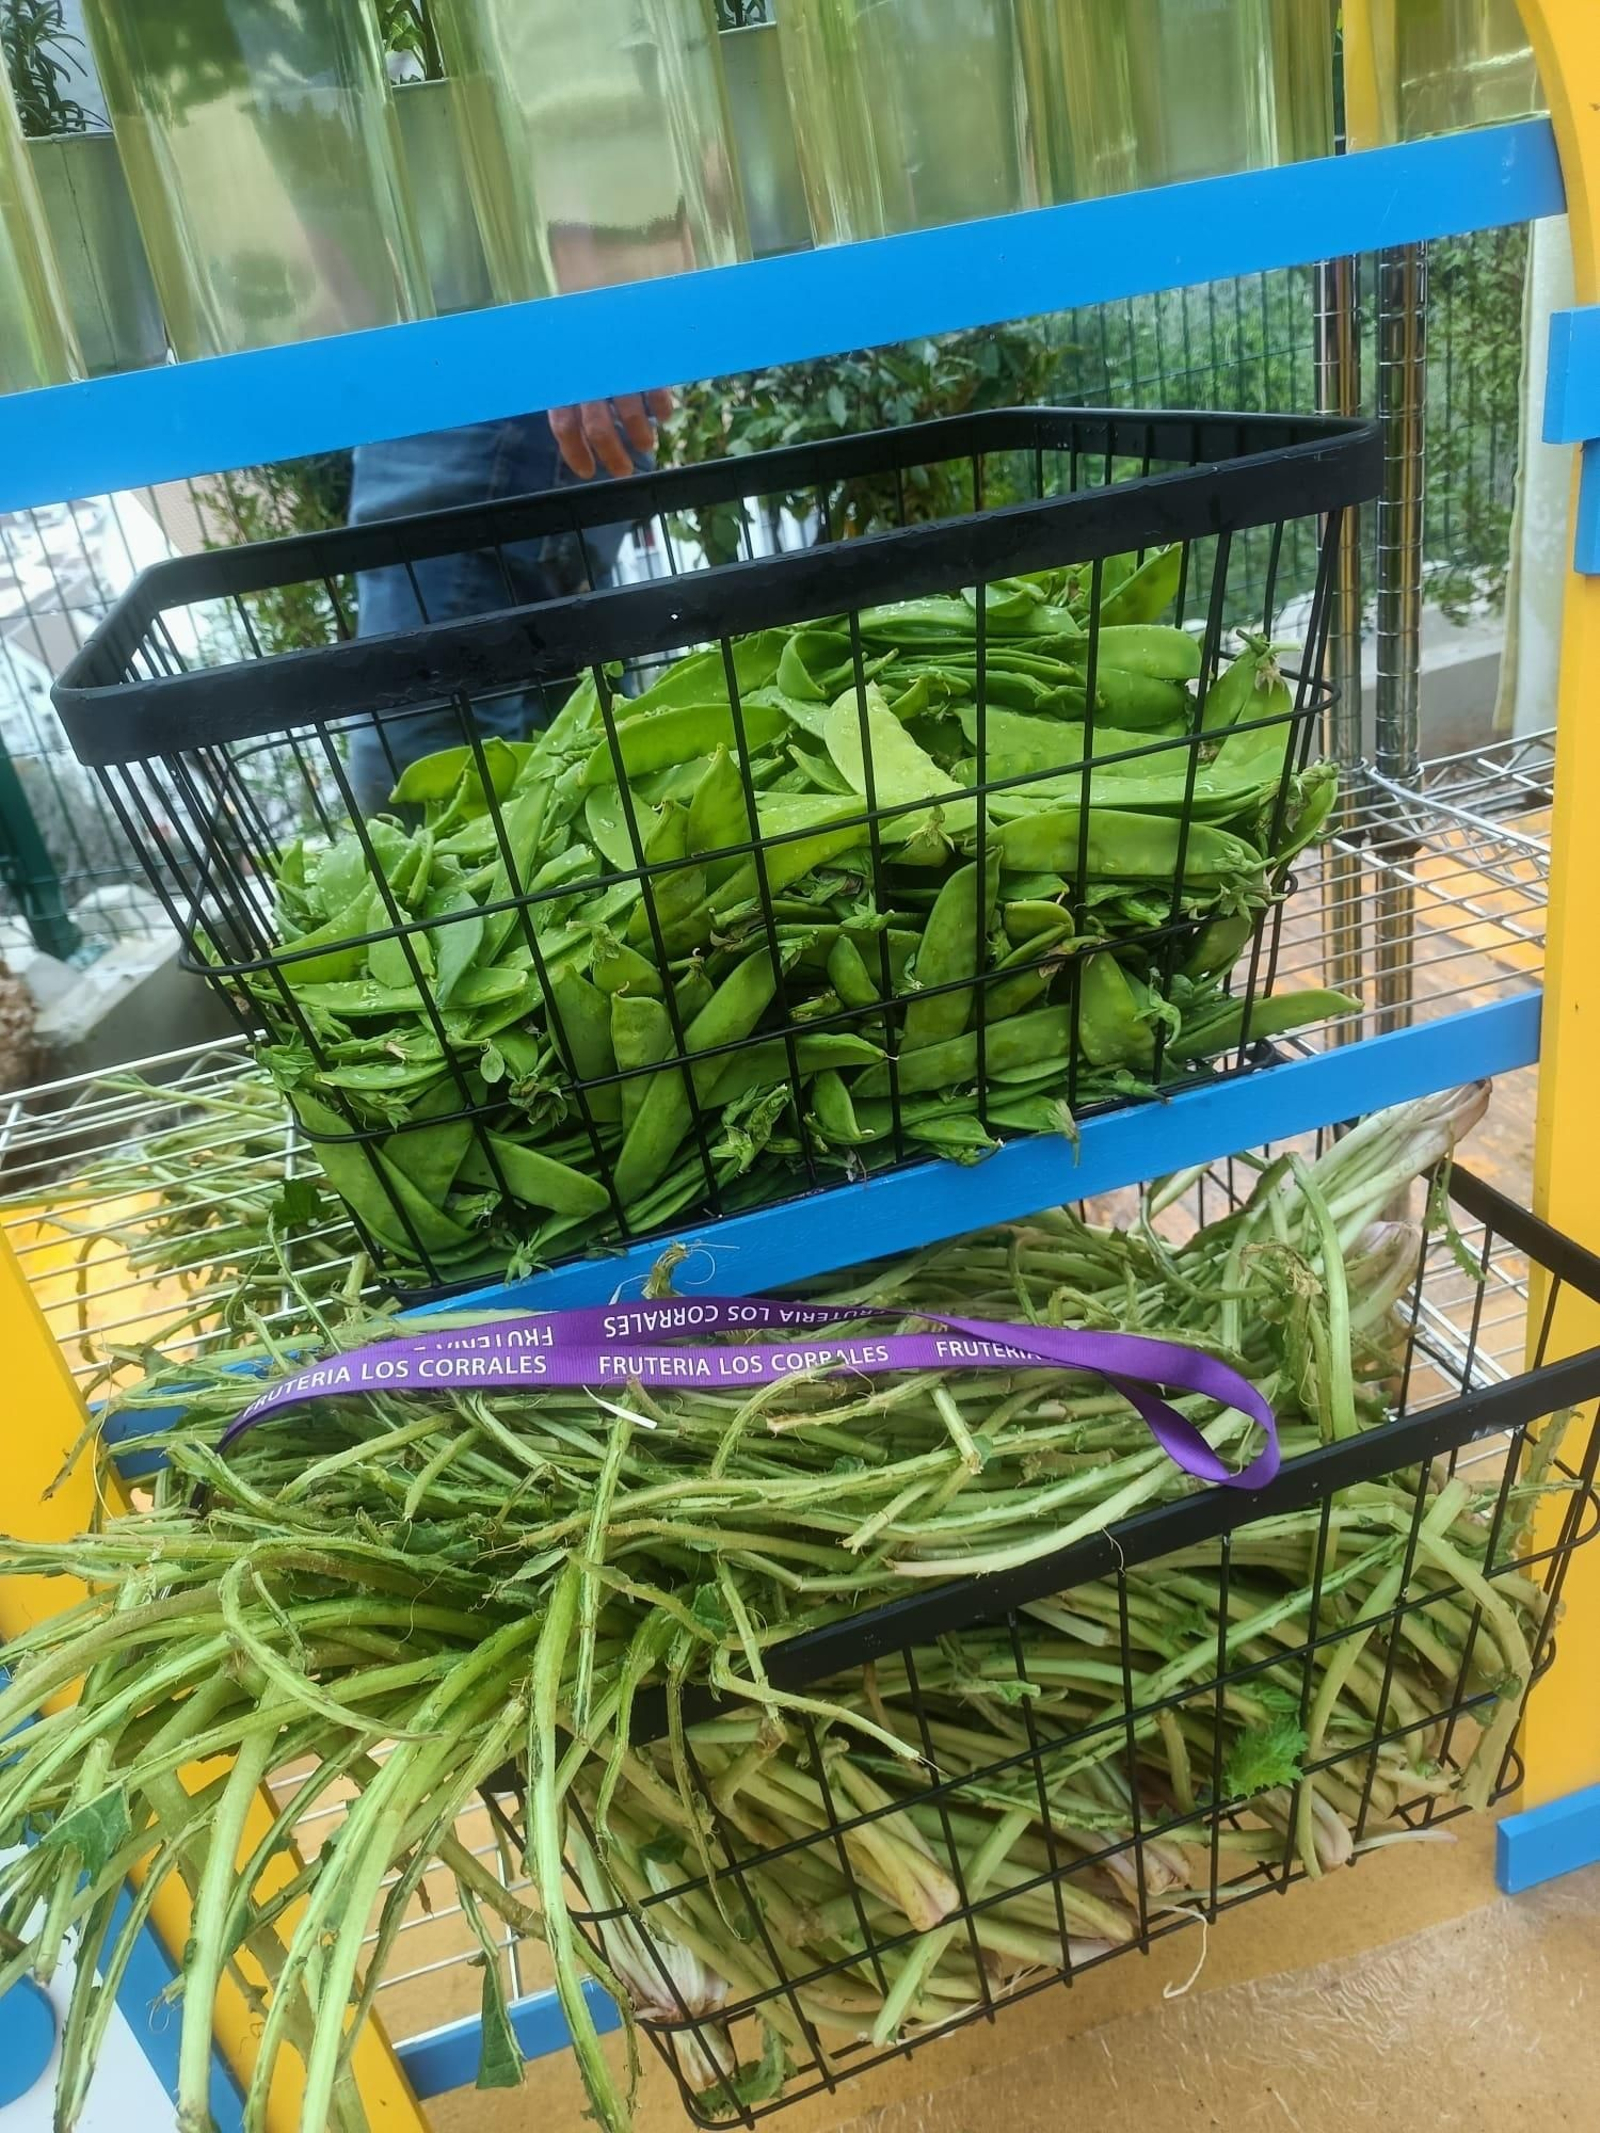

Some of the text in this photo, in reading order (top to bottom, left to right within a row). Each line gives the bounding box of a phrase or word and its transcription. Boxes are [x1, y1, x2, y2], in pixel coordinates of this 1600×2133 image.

[602, 1305, 719, 1338] CORRALES
[727, 1306, 770, 1321] LOS
[599, 1356, 711, 1376] FRUTERIA
[720, 1355, 762, 1376] LOS
[243, 1355, 547, 1418] FRUTERIA LOS CORRALES
